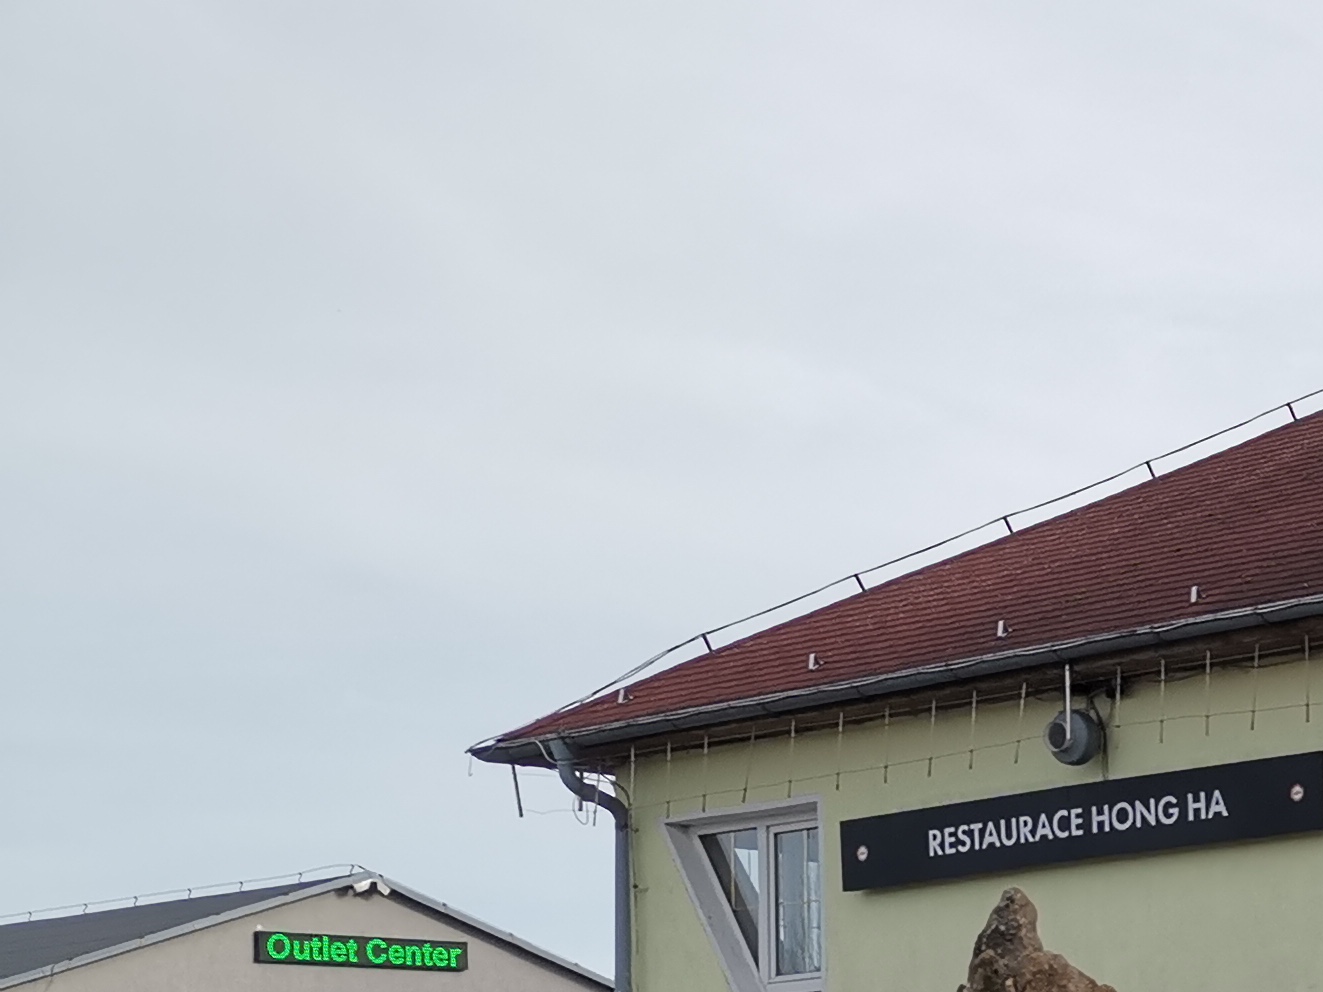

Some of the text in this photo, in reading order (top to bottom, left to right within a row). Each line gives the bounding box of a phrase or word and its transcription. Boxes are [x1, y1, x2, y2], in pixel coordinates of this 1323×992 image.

[927, 788, 1229, 858] RESTAURACE HONG HA
[266, 933, 463, 968] Outlet Center
